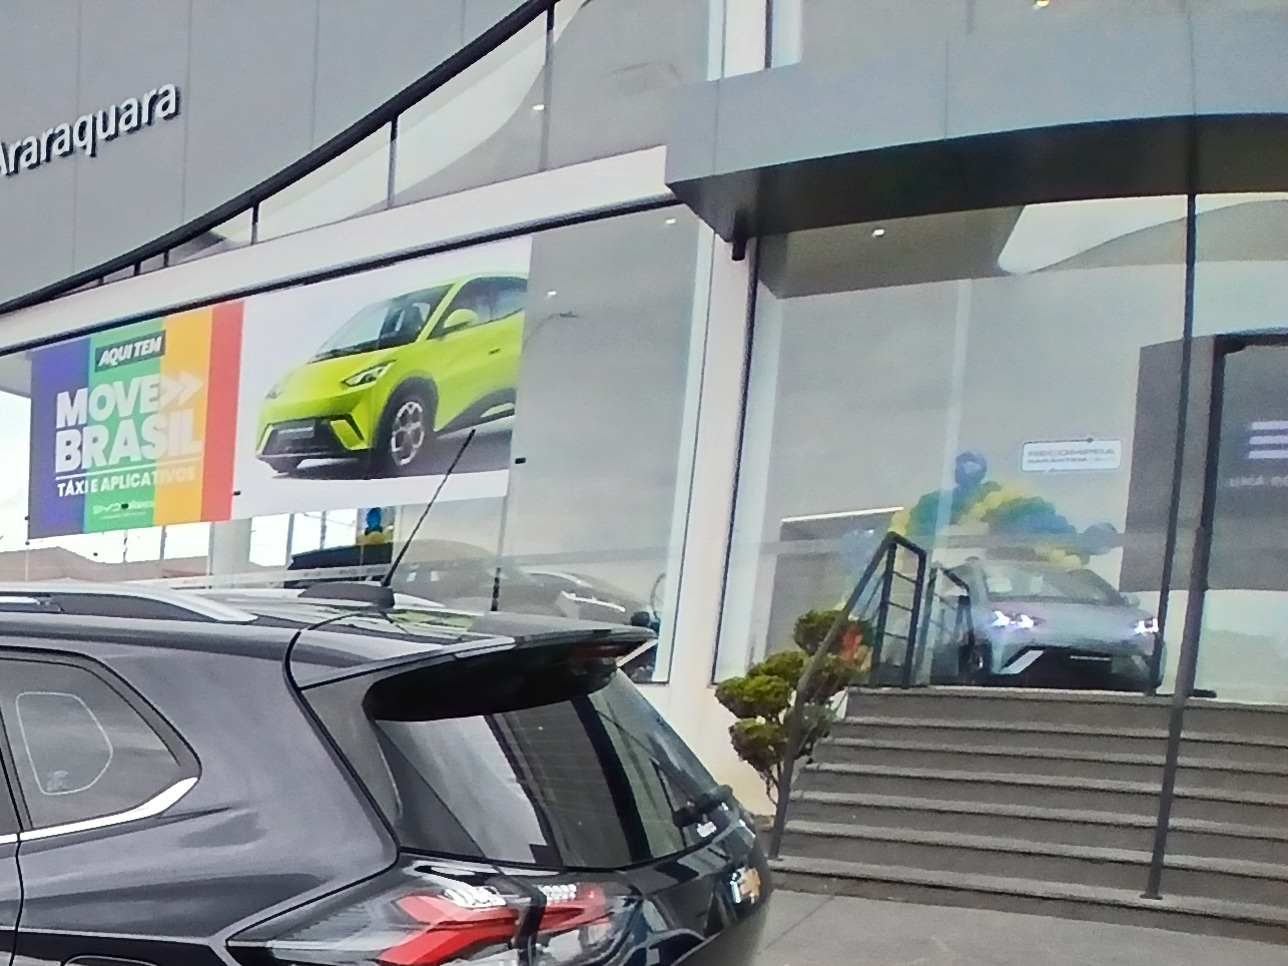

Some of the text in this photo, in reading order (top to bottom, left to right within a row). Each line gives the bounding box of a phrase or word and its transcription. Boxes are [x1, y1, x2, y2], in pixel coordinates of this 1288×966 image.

[97, 335, 163, 367] AQUI TEM
[56, 373, 162, 429] MOVE
[55, 408, 203, 473] BRASIL
[90, 477, 99, 493] E
[100, 465, 196, 492] APLICATIVOS
